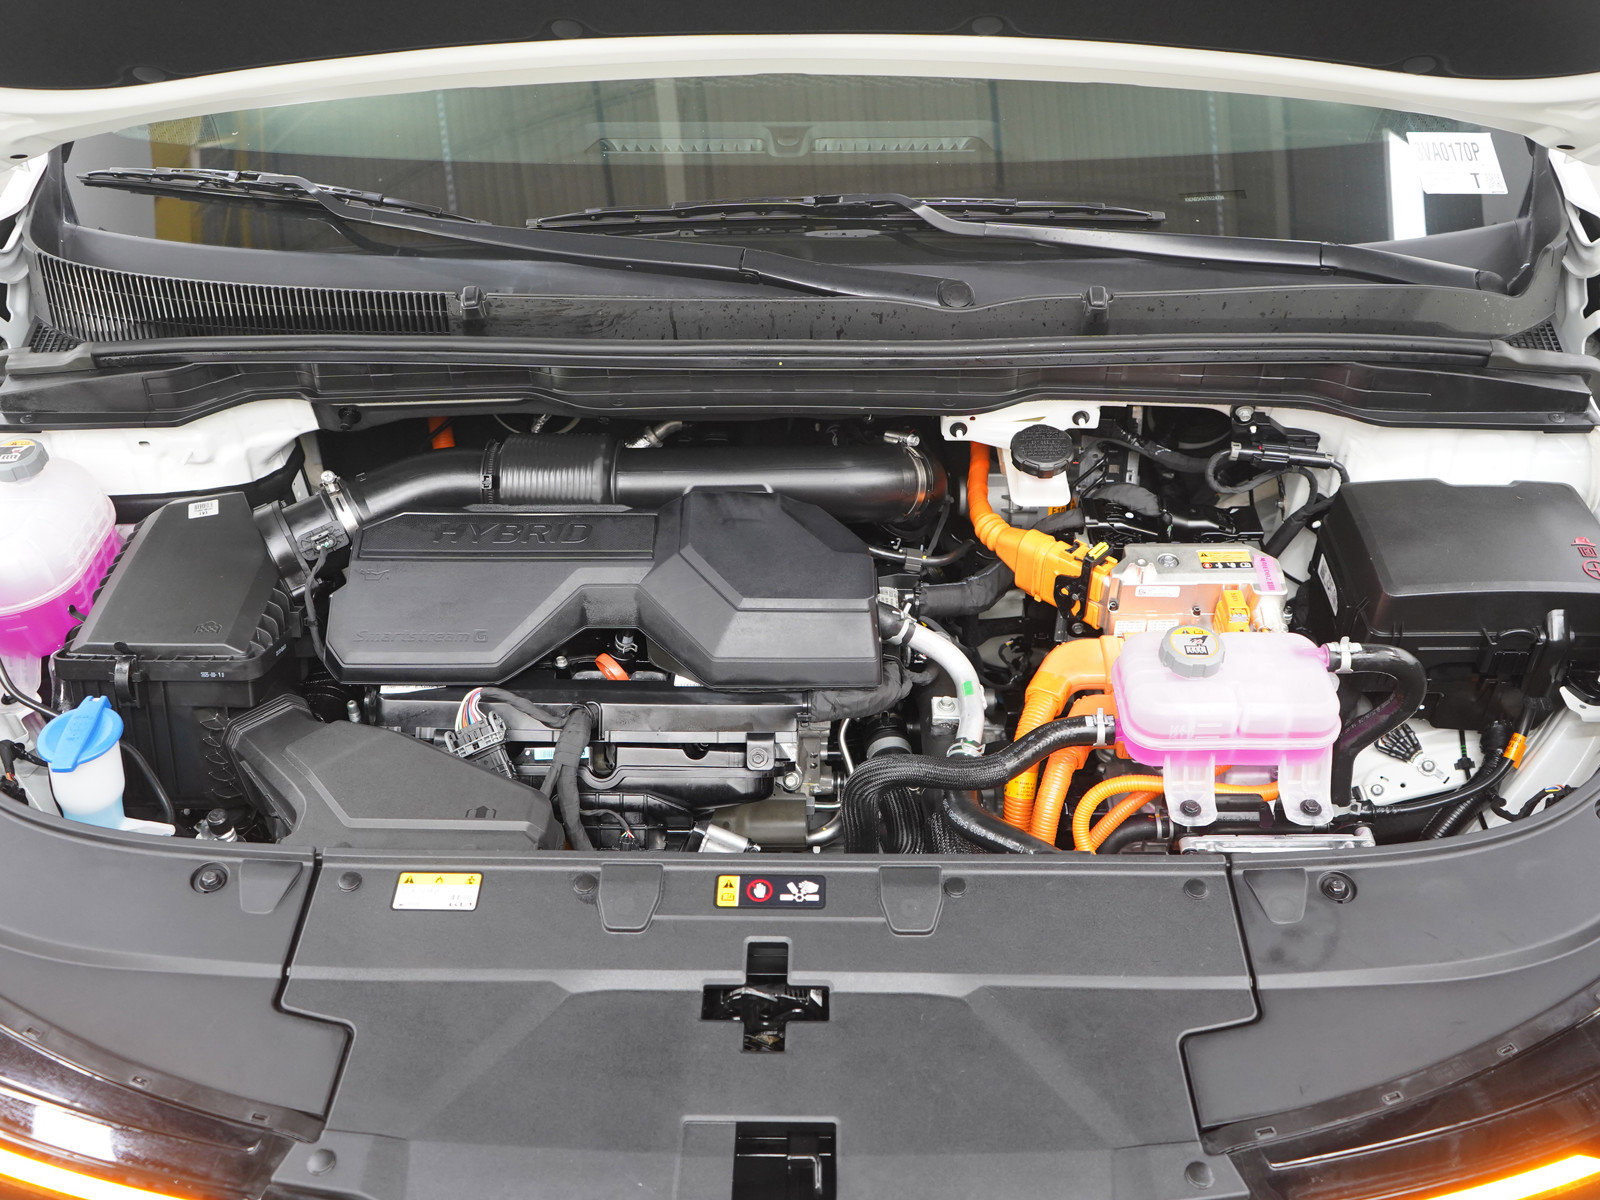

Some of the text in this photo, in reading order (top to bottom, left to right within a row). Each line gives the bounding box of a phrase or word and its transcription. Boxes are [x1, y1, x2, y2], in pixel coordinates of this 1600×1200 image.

[1470, 172, 1480, 188] T
[433, 523, 593, 544] HYBRID
[353, 629, 471, 643] Smartstream
